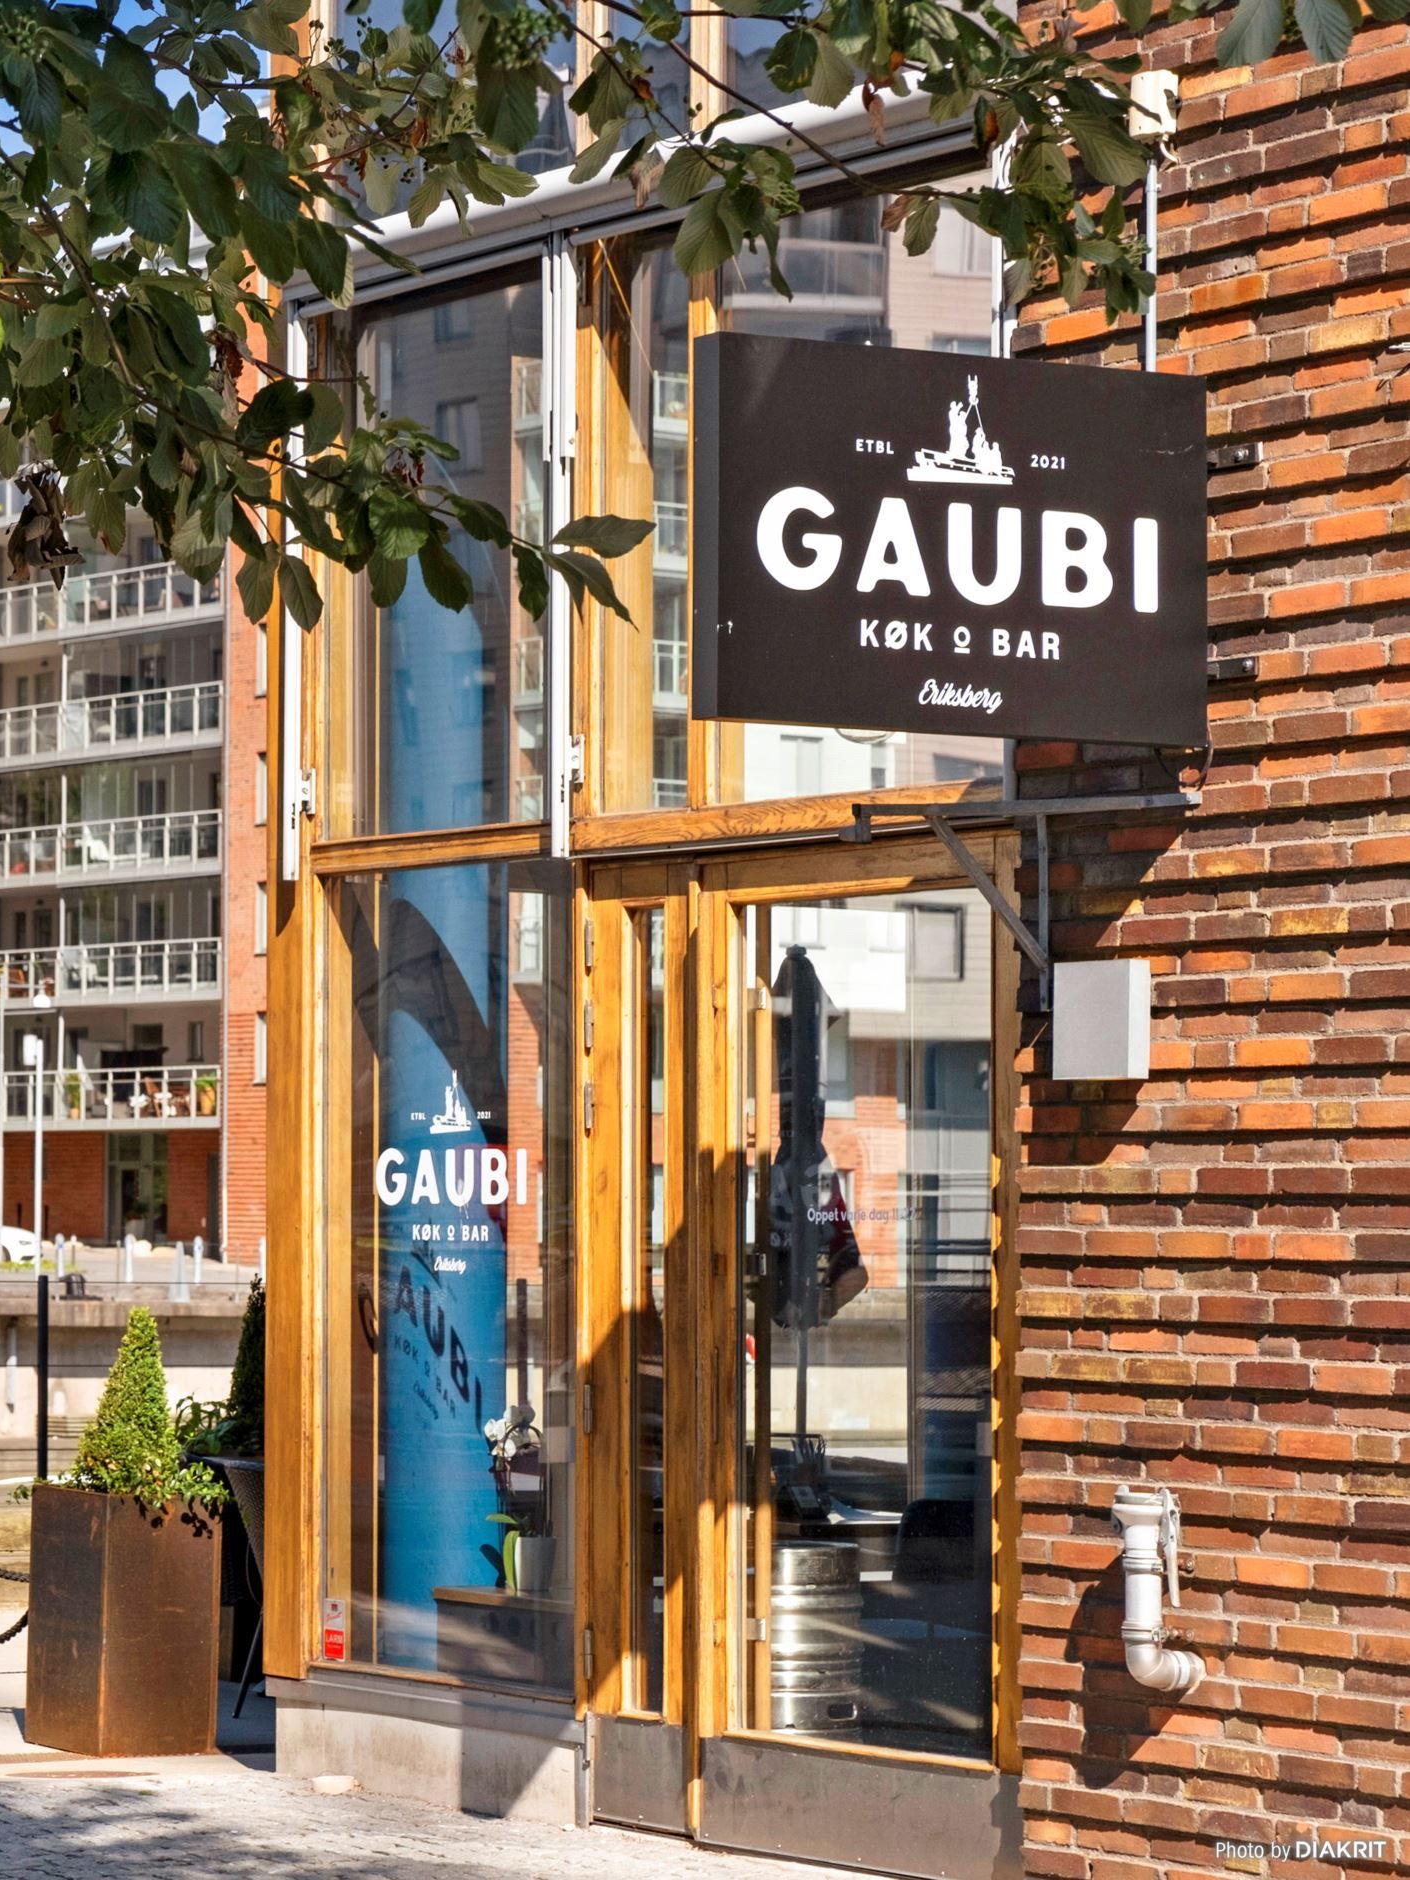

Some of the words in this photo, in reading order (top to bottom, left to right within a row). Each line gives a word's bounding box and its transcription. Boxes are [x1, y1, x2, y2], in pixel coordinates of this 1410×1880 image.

[856, 438, 895, 455] ETBL
[1030, 453, 1066, 470] 2021
[756, 486, 1159, 613] GAUBI
[859, 618, 934, 652] KØK
[992, 628, 1060, 661] BAR
[918, 678, 1003, 714] Eriksberg
[410, 1111, 427, 1121] ETBL
[375, 1147, 528, 1207] GAUBI
[807, 1203, 839, 1225] Öppet
[412, 1223, 441, 1242] KØK
[462, 1223, 489, 1242] BAR
